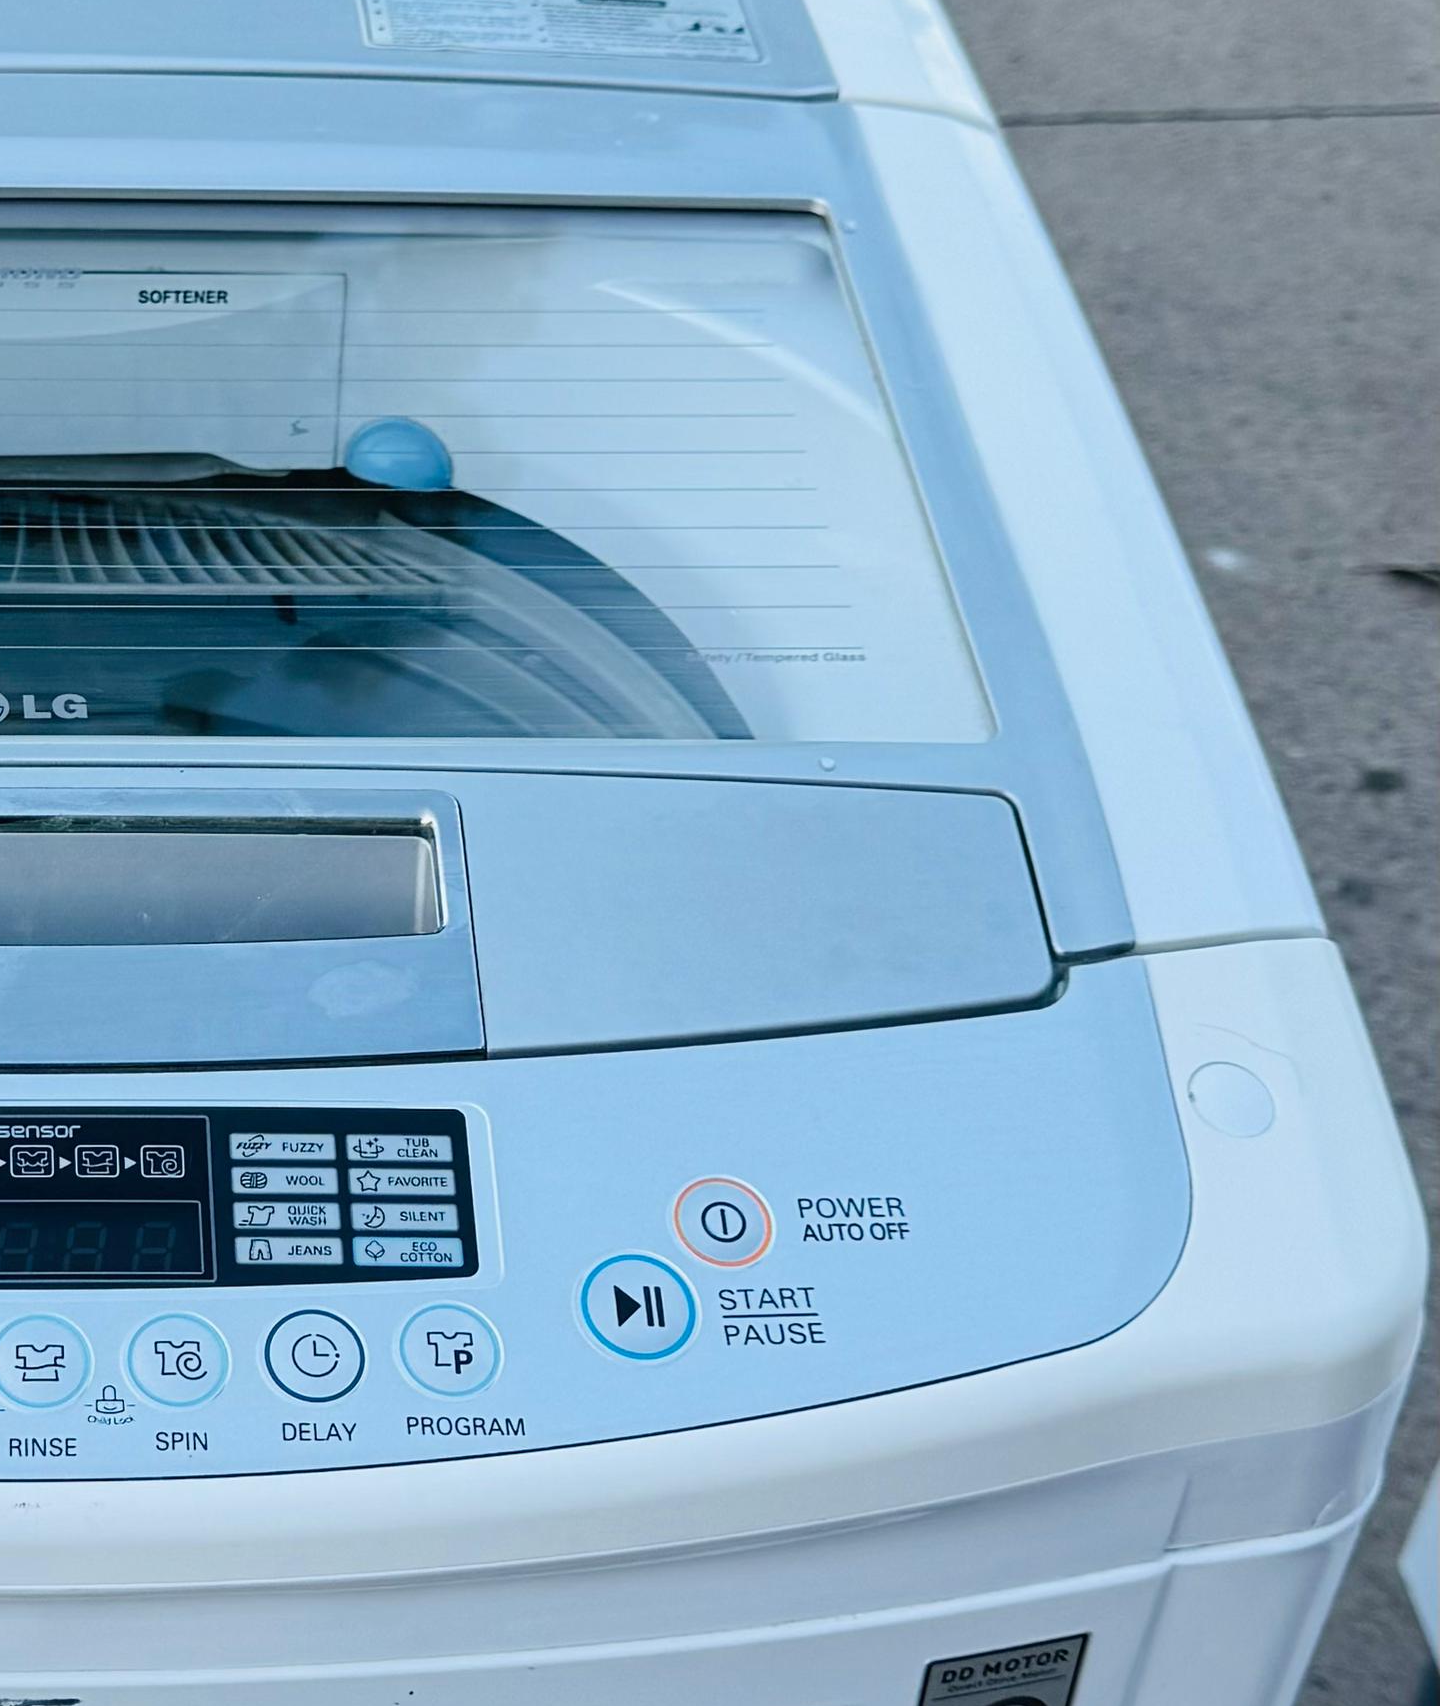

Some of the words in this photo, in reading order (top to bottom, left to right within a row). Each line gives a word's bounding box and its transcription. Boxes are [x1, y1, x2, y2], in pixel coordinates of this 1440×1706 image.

[137, 289, 229, 305] SOFTENER
[22, 693, 89, 720] LG
[281, 1141, 325, 1153] FUZZY
[403, 1137, 430, 1148] TUB
[396, 1148, 439, 1159] CLEAN
[285, 1175, 325, 1187] WOOL
[387, 1176, 449, 1188] FAVORITE
[287, 1204, 327, 1216] QUICK
[797, 1196, 906, 1219] POWER
[287, 1215, 327, 1227] WASH
[399, 1211, 446, 1222] SILENT
[802, 1223, 864, 1242] AUTO
[869, 1221, 911, 1241] OFF
[287, 1245, 333, 1257] JEANS
[411, 1241, 438, 1253] ECO
[399, 1251, 453, 1263] COTTON
[718, 1286, 815, 1311] START
[723, 1322, 827, 1346] PAUSE
[280, 1420, 357, 1443] DELAY
[405, 1414, 527, 1438] PROGRAM
[8, 1436, 78, 1459] RINSE
[154, 1430, 209, 1453] SPIN
[940, 1666, 975, 1685] DD
[982, 1648, 1069, 1677] MOTOR
